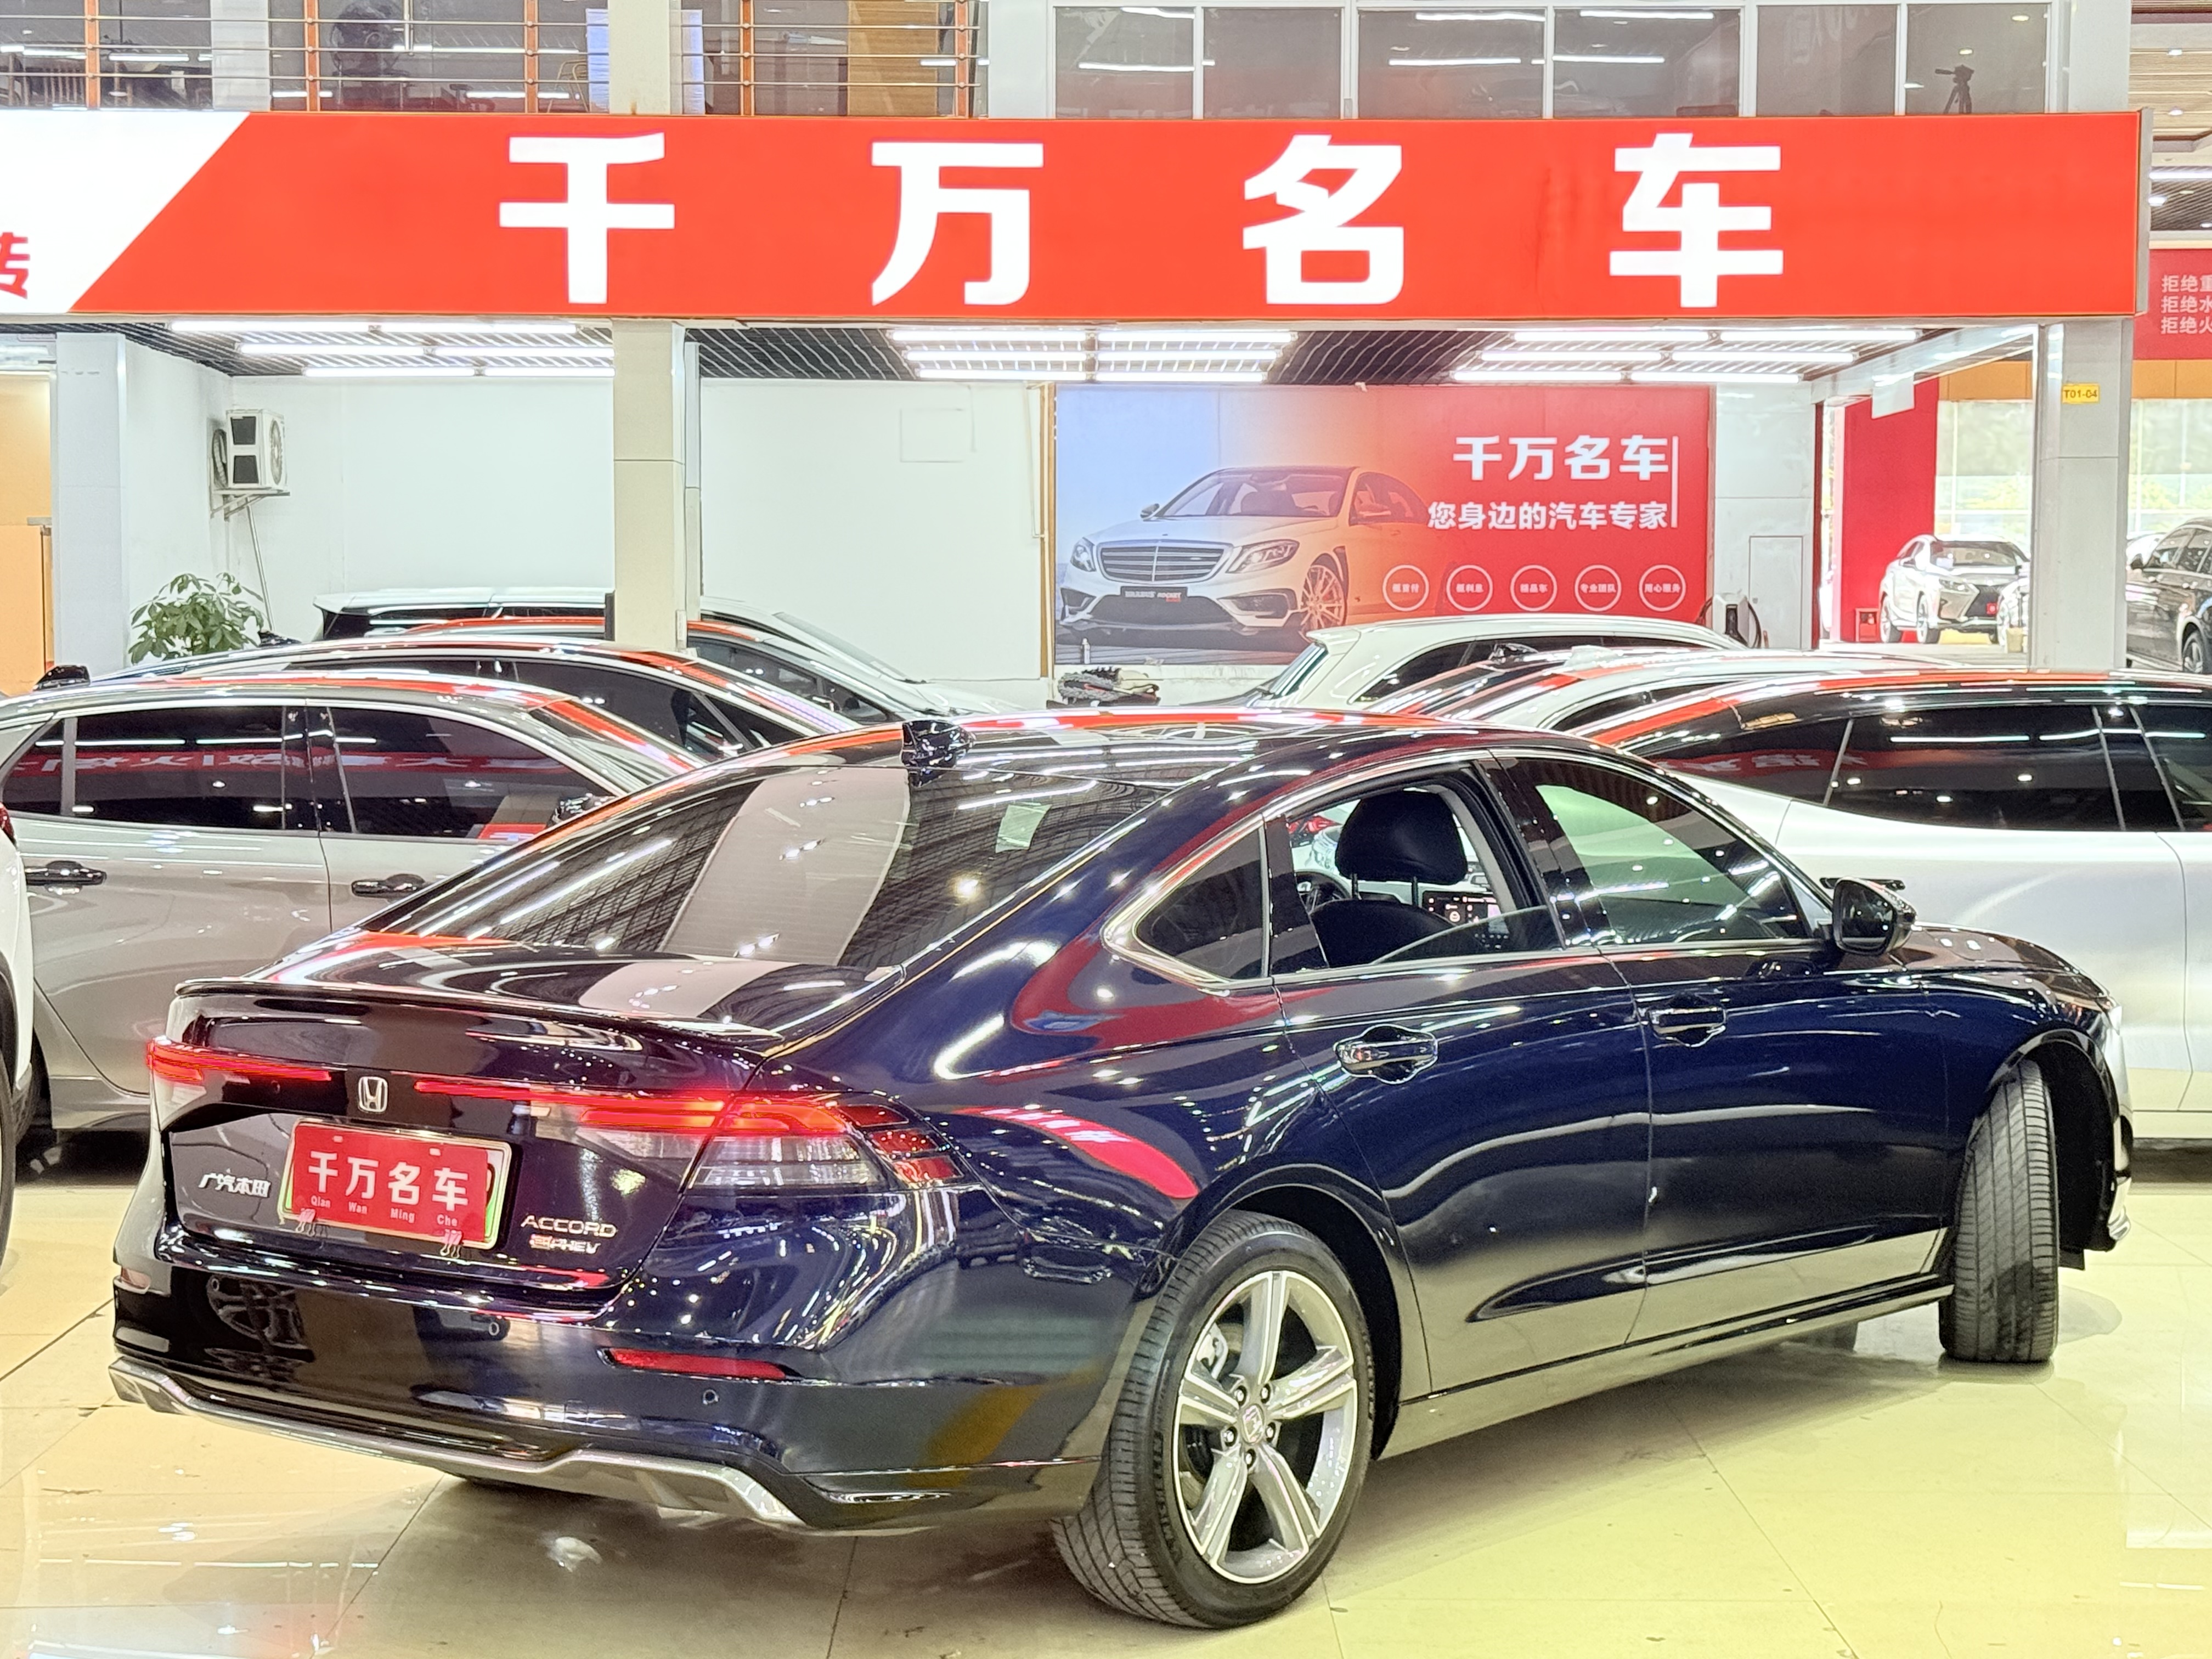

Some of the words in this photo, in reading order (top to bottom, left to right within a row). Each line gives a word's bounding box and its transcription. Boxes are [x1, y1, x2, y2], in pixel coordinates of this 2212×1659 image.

[499, 132, 1784, 308] 千万名车
[1453, 435, 1669, 481] 千万名车
[1427, 500, 1668, 531] 您身边的汽车专家
[198, 1167, 271, 1198] 广汽本田
[308, 1150, 470, 1212] 千万名车
[311, 1195, 331, 1209] Qian
[348, 1201, 368, 1214] Wan
[390, 1207, 415, 1223] Ming
[437, 1214, 458, 1227] Che
[520, 1214, 618, 1238] ACCORD
